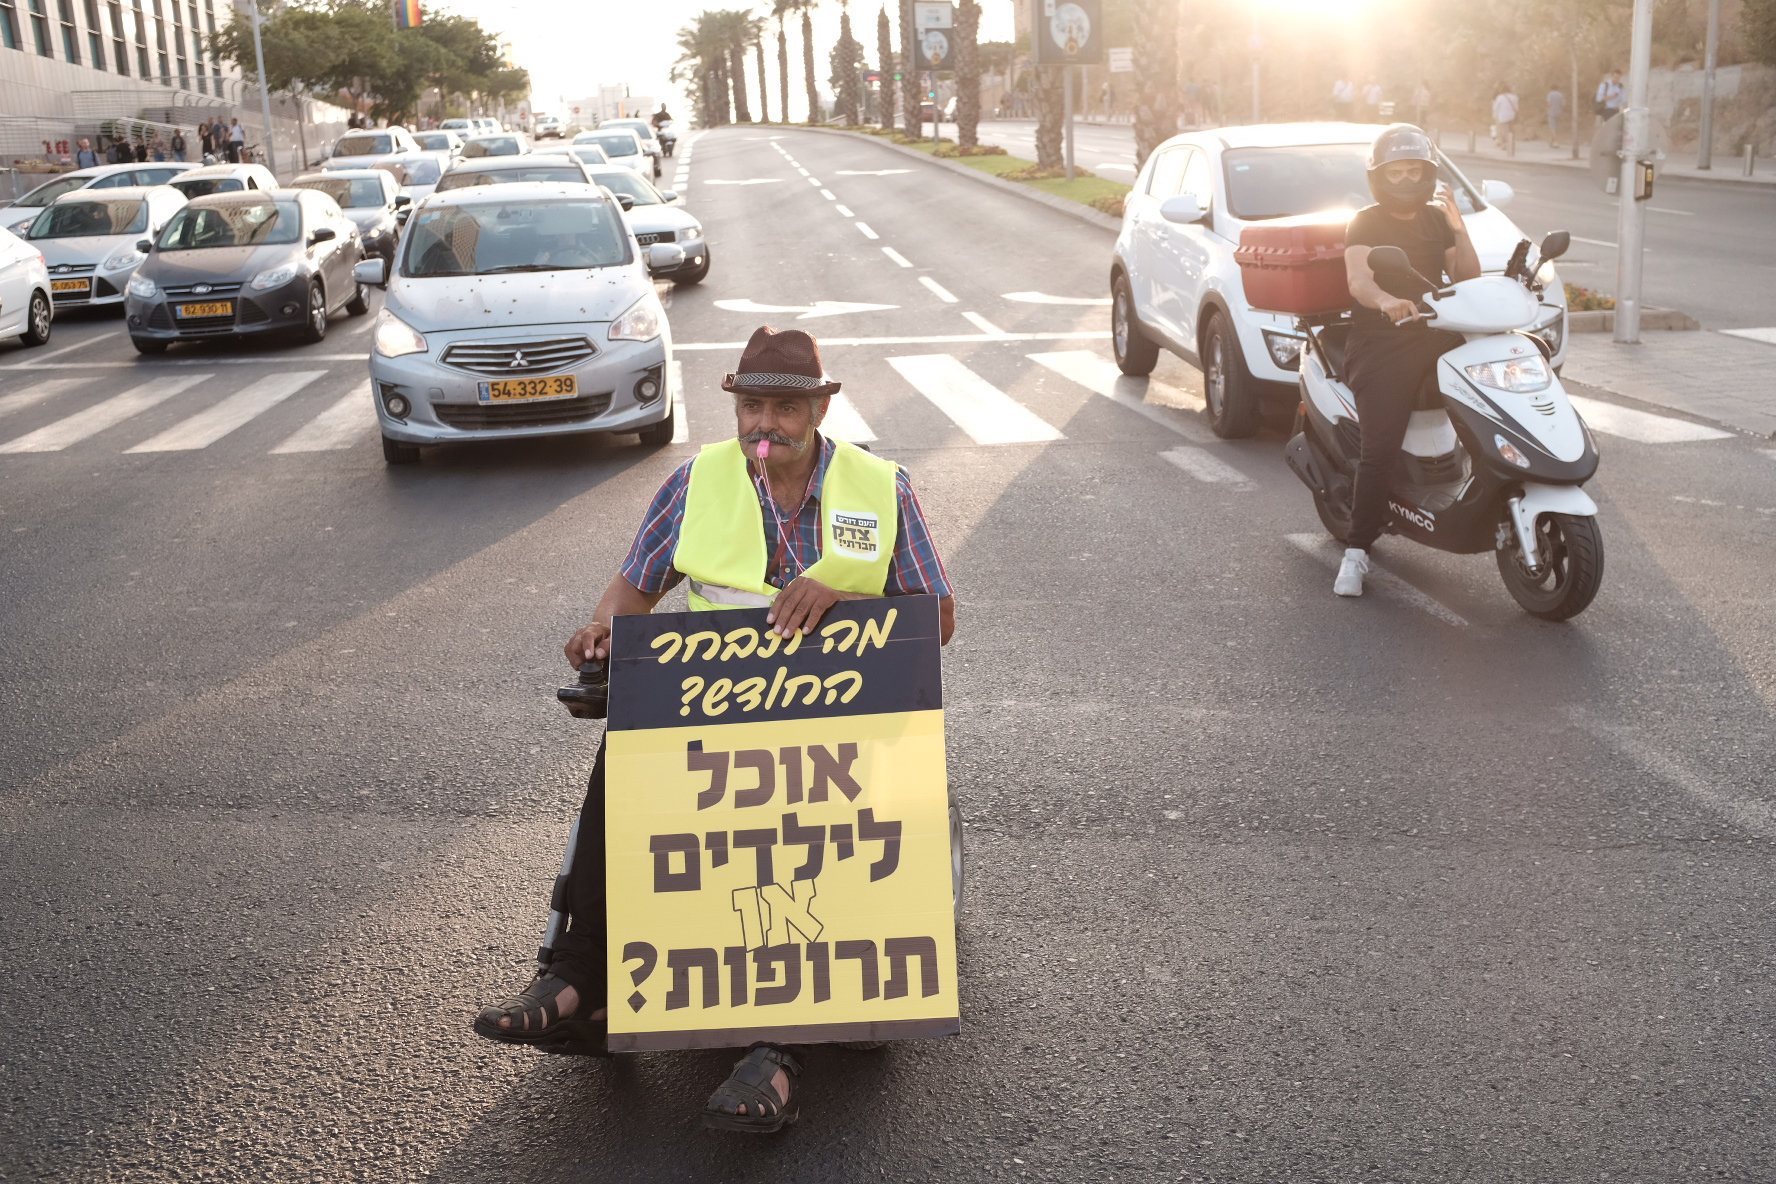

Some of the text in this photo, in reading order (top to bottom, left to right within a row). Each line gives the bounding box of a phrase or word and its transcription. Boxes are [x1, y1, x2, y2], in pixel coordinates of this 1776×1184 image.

[832, 524, 870, 541] צדק
[837, 516, 875, 528] העם דורש
[1388, 500, 1435, 532] KYMCO
[821, 608, 898, 657] מה
[679, 666, 863, 717] החודש?
[687, 739, 862, 811] אוכל
[649, 807, 902, 893] לילדים
[731, 878, 824, 953] או
[621, 935, 940, 1014] תרופות?
